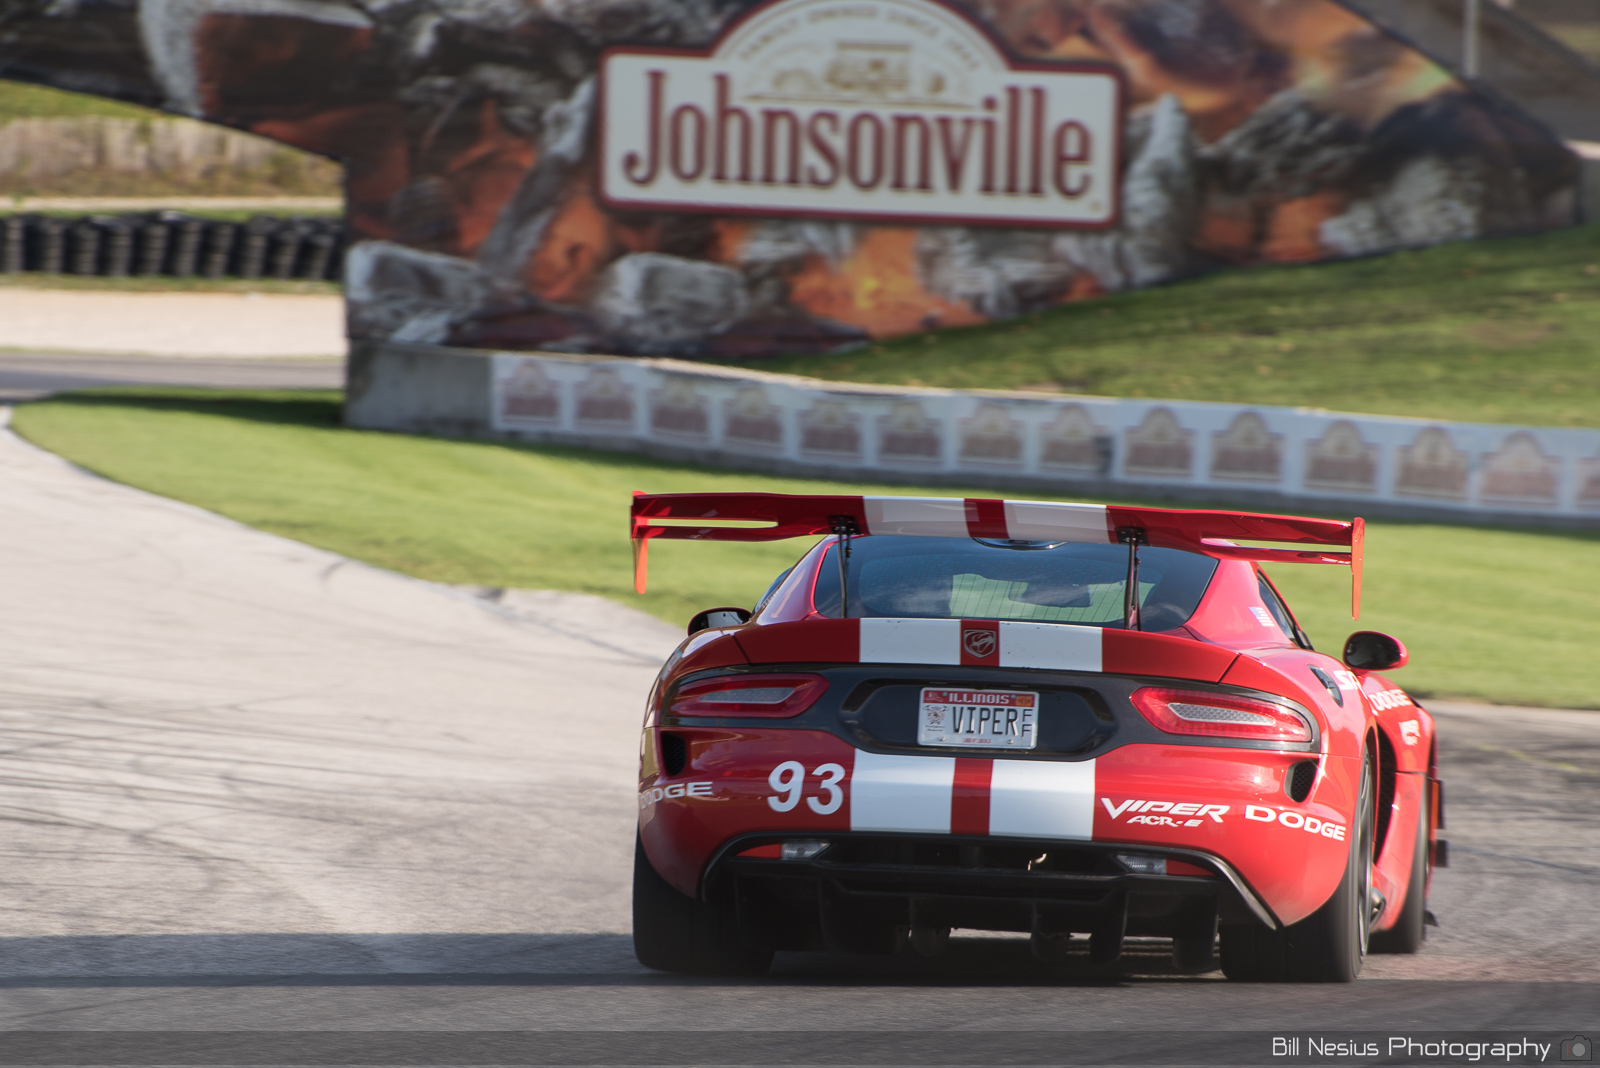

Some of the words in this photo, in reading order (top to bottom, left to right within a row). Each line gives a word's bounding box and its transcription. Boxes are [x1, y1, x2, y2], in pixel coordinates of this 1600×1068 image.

[622, 69, 1093, 199] Johnsonville
[948, 692, 1010, 705] ILLINOIS
[952, 705, 1019, 737] VIPER
[767, 760, 846, 816] 93
[1100, 797, 1231, 823] VIPER
[1244, 804, 1347, 842] DODGE
